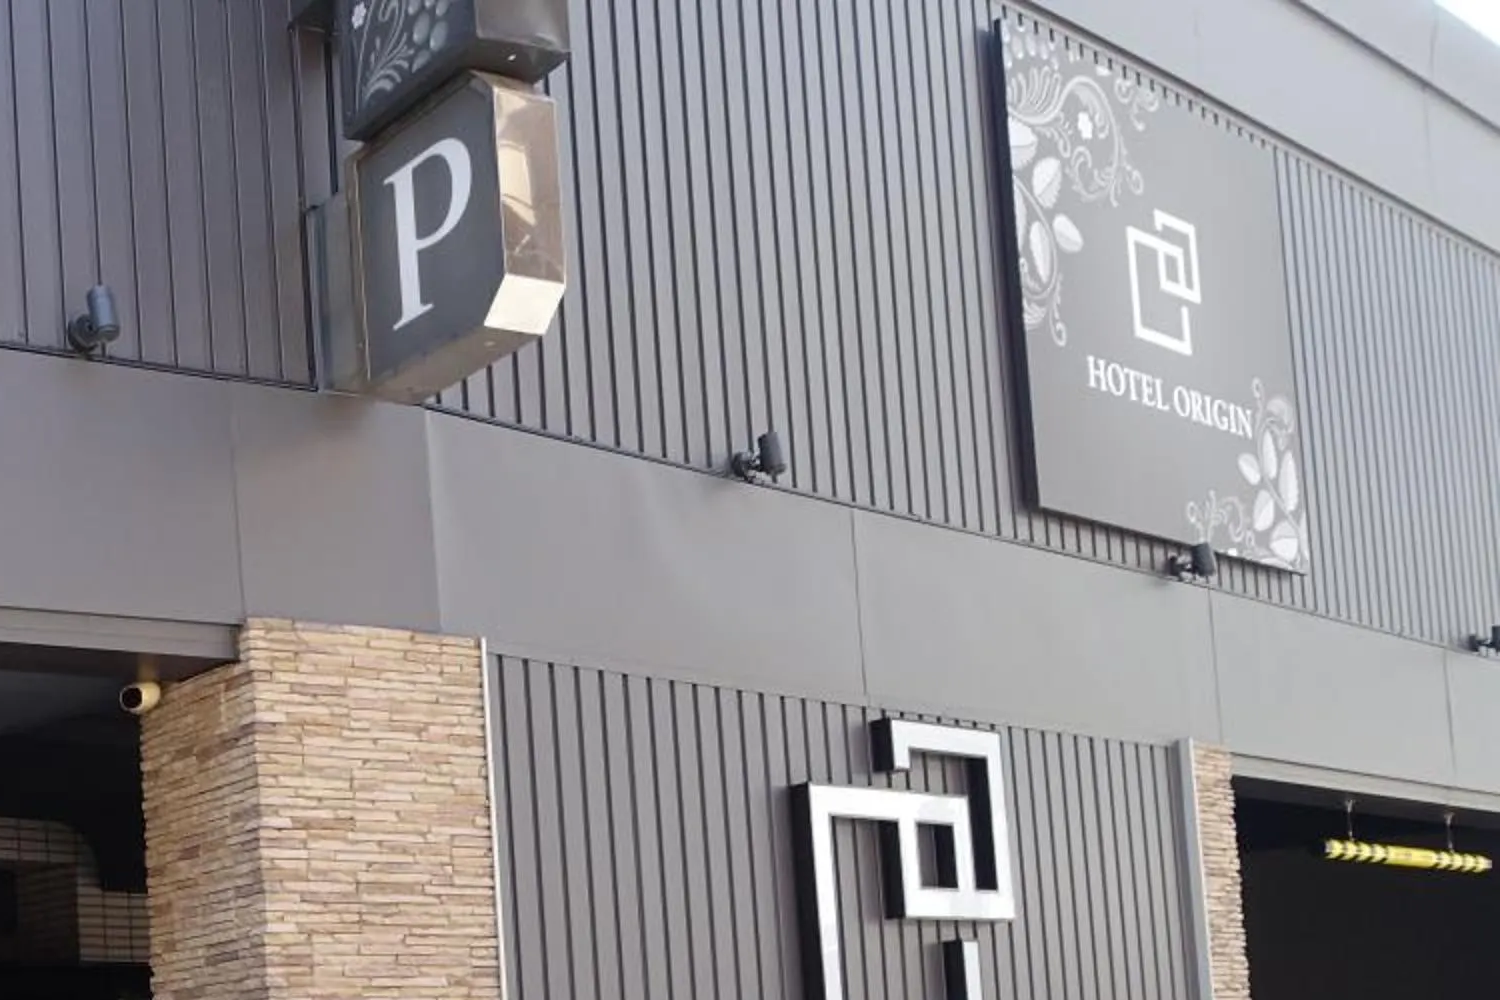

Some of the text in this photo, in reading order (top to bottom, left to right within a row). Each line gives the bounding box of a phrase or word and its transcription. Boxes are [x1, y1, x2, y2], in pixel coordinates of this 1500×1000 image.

[382, 137, 473, 331] P
[1087, 355, 1253, 439] HOTEL ORIGIN
